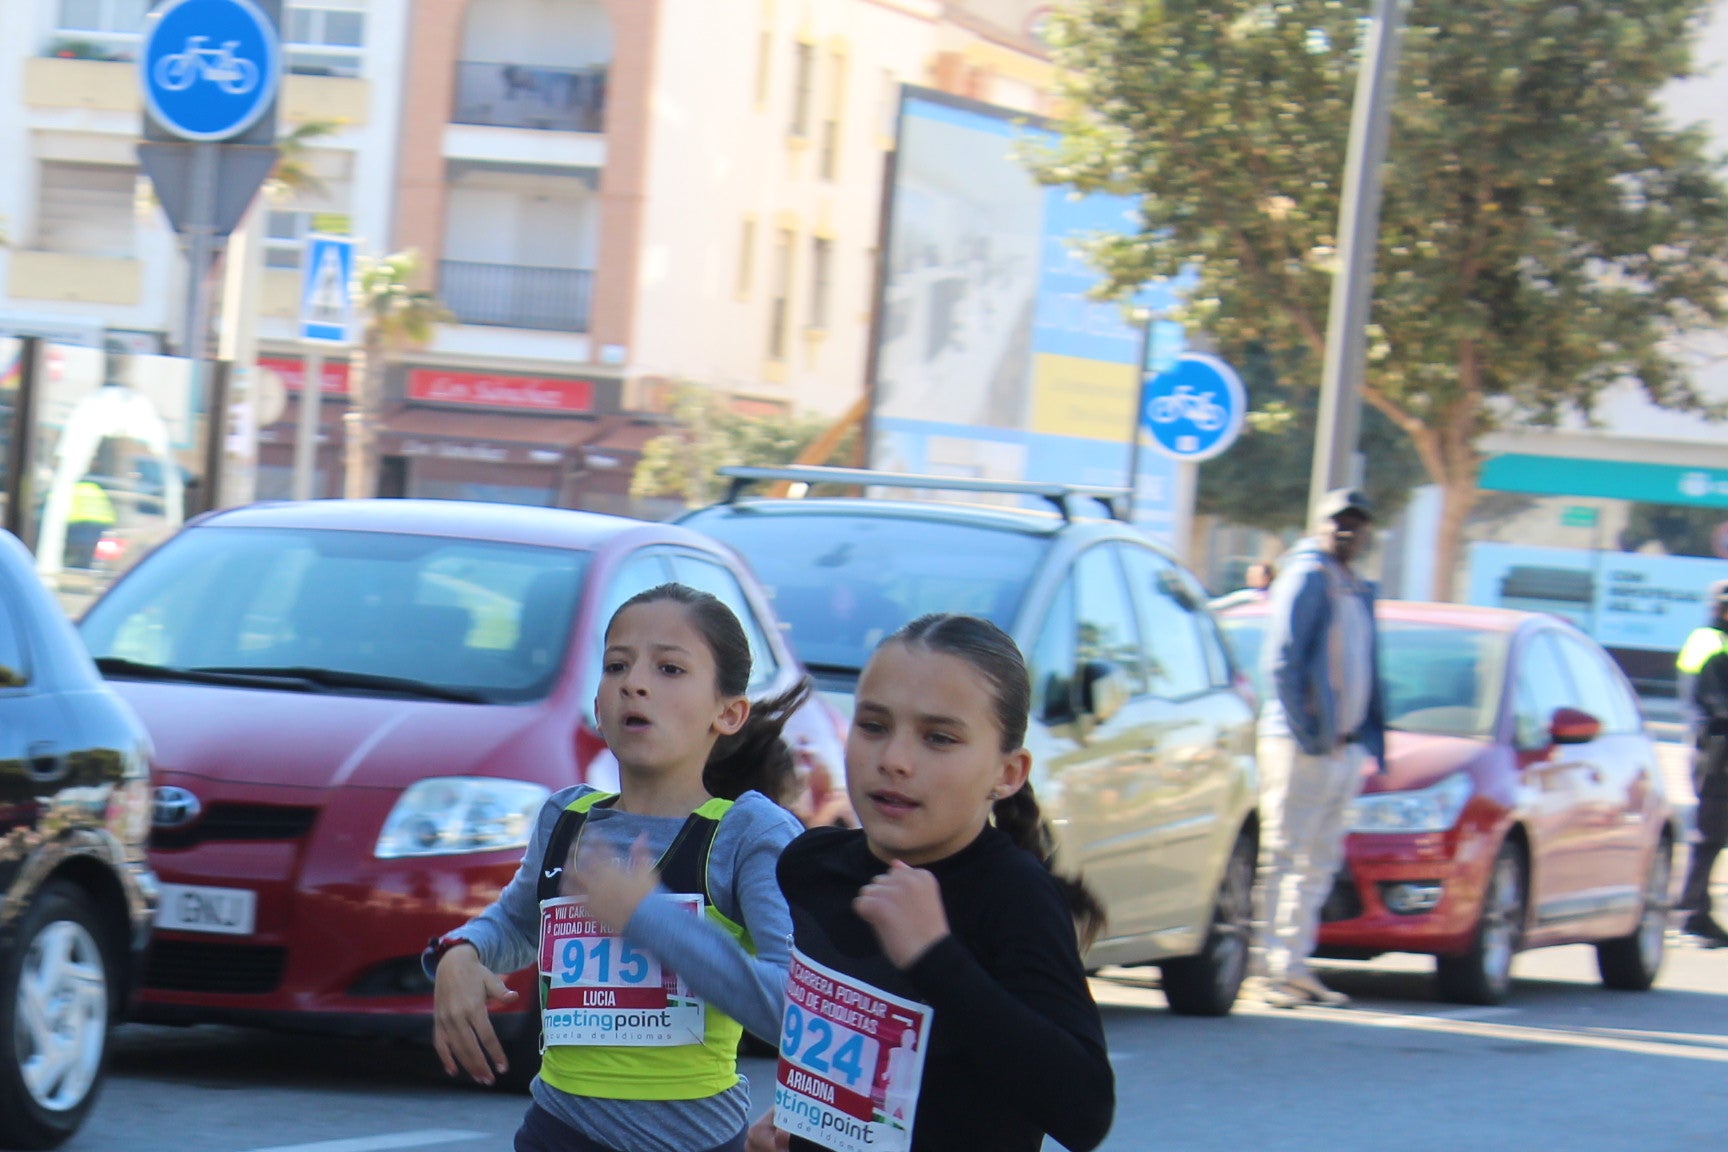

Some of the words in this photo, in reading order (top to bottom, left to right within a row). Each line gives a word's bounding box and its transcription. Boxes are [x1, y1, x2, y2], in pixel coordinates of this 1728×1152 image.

[553, 921, 583, 936] CIUDAD
[585, 921, 598, 934] DE
[560, 938, 649, 984] 915
[583, 990, 617, 1006] LUCIA
[795, 963, 834, 996] CARRERA
[835, 986, 888, 1018] POPULAR
[805, 992, 820, 1010] DE
[820, 998, 879, 1034] ROQUETAS
[781, 1004, 865, 1085] 924
[787, 1068, 835, 1103] ARIADNA
